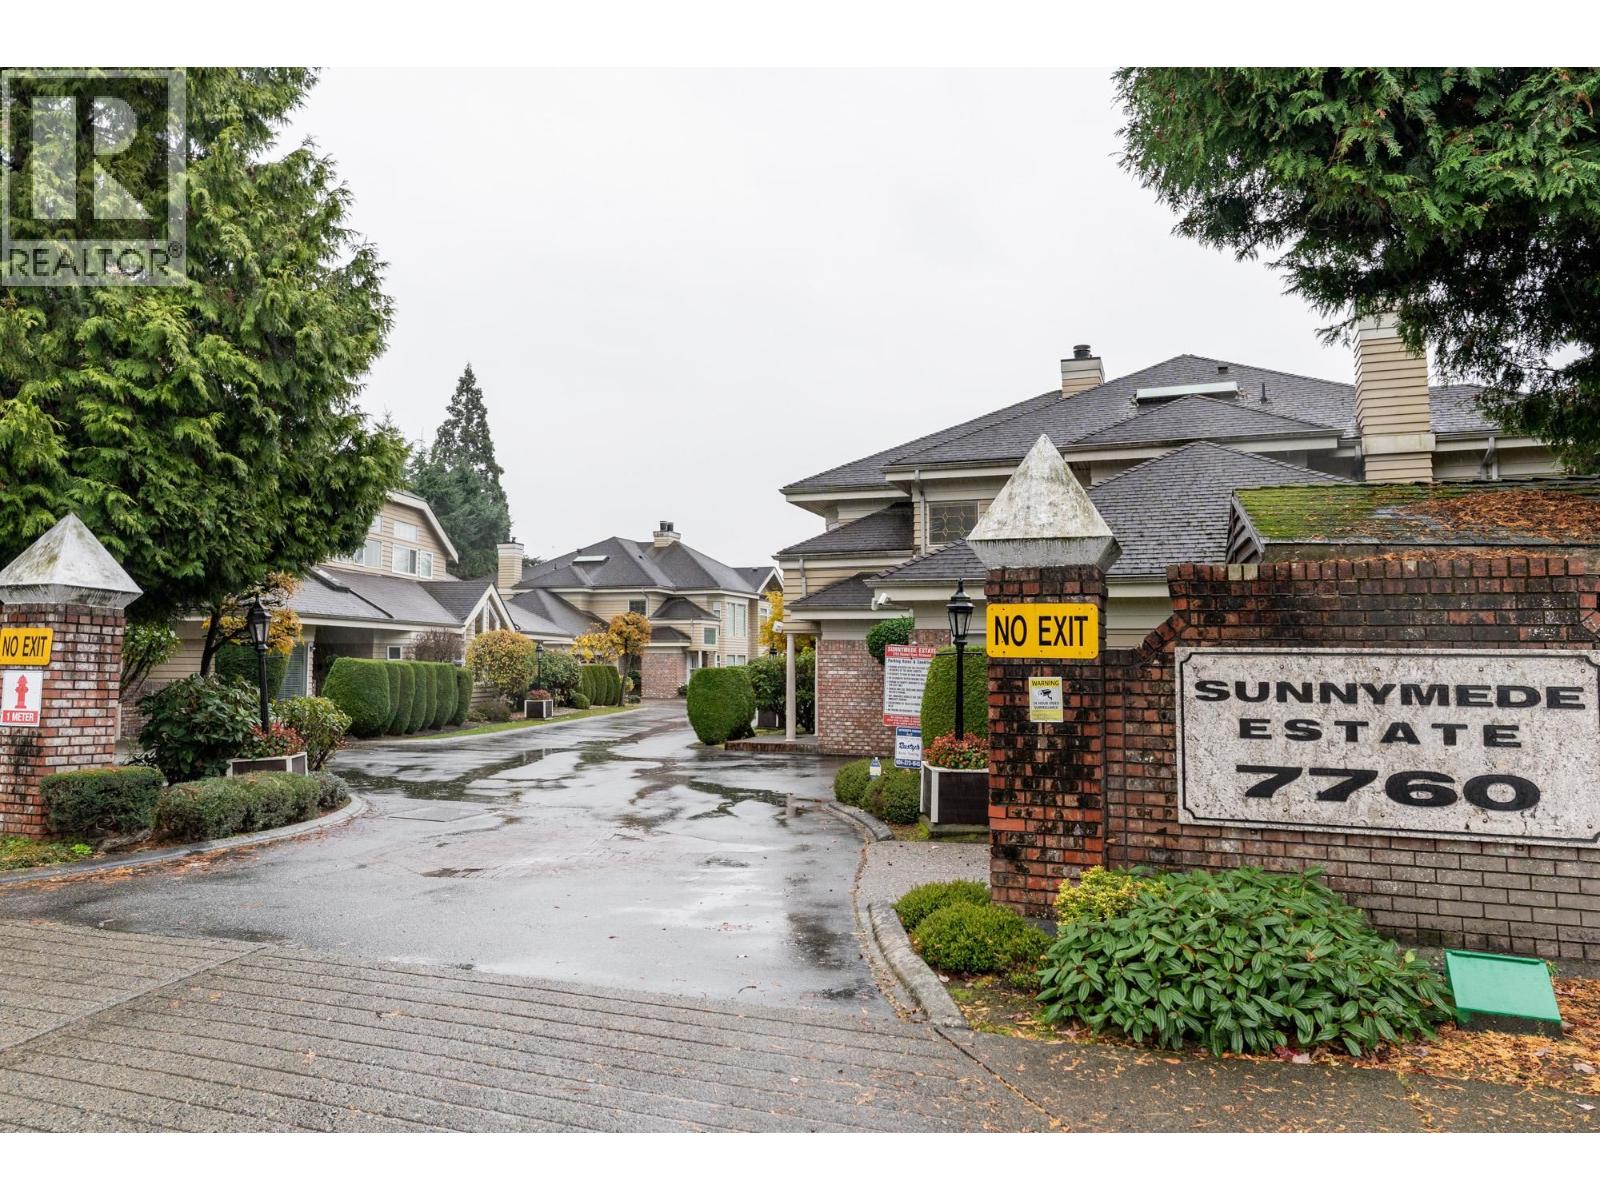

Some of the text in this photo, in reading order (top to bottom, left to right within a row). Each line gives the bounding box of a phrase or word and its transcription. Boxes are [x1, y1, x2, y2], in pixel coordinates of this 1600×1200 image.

[2, 635, 47, 657] NO EXIT
[994, 615, 1088, 647] NO EXIT
[1194, 680, 1586, 710] SUNNYMEDE
[6, 712, 34, 722] 1 METER
[1239, 718, 1522, 748] ESTATE
[1236, 764, 1541, 811] 7760
